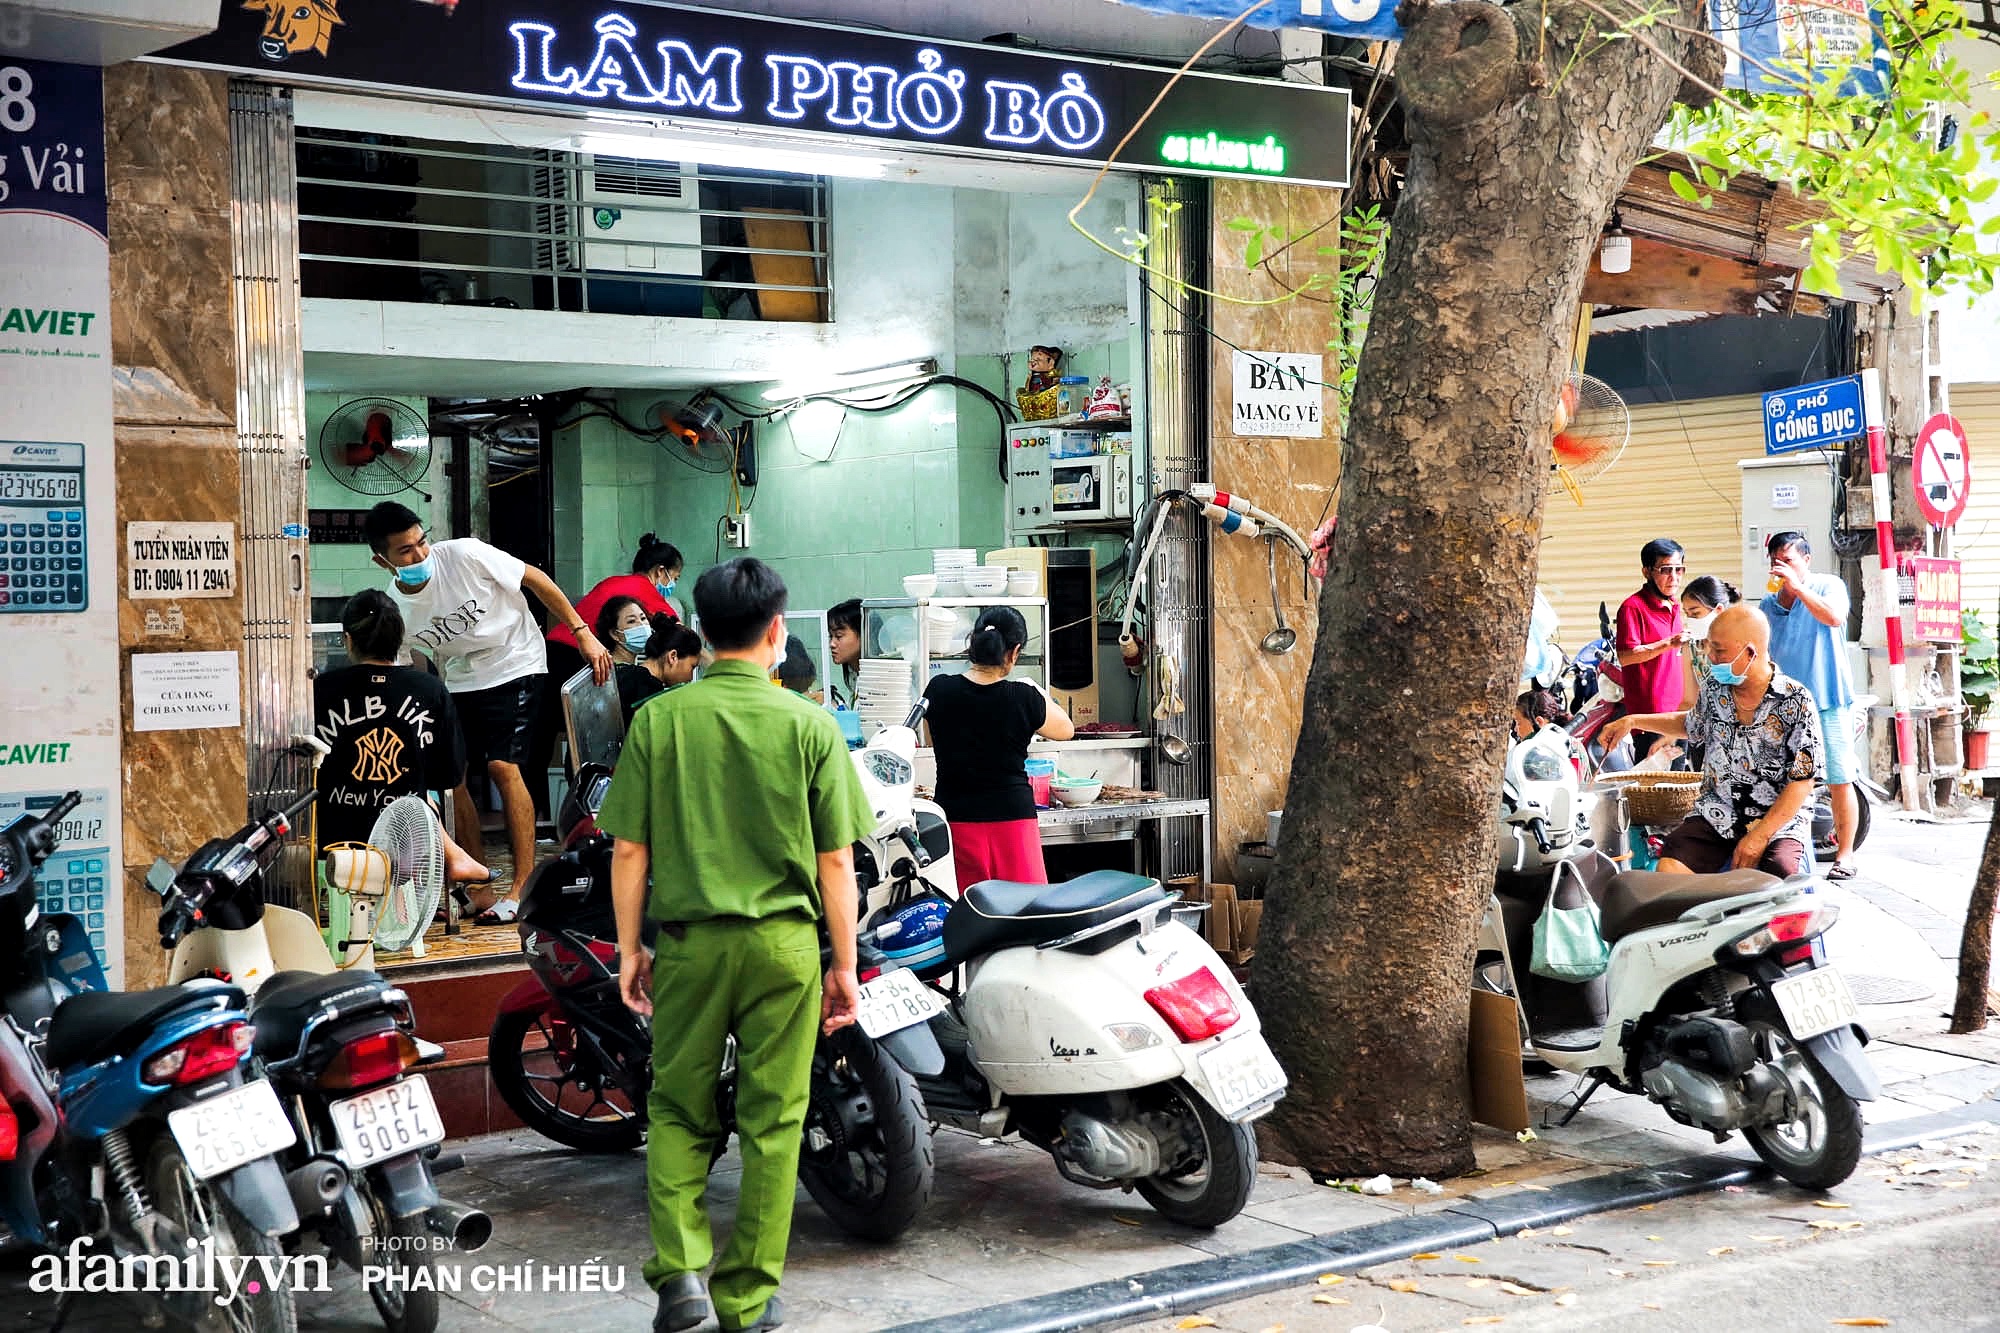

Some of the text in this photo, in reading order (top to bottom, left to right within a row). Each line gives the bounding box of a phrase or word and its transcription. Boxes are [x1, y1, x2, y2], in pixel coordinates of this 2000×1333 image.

[508, 12, 1105, 151] LÂM PHỞ BÒ
[21, 142, 86, 194] Vải
[0, 307, 96, 337] AVIET
[1249, 356, 1307, 392] BÁN
[1236, 402, 1291, 422] MANG
[1796, 388, 1829, 411] PHỐ
[1774, 407, 1855, 443] CỔNG ĐỤC
[172, 535, 202, 560] NHÂN
[204, 535, 229, 560] VIÊN
[134, 568, 230, 591] ĐT: 0904 11 2941
[412, 599, 488, 648] DIOR
[316, 695, 387, 746] MLB
[328, 785, 367, 806] New
[1656, 930, 1710, 949] VISION
[350, 1084, 419, 1130] 29-P2
[357, 1112, 428, 1159] 9064
